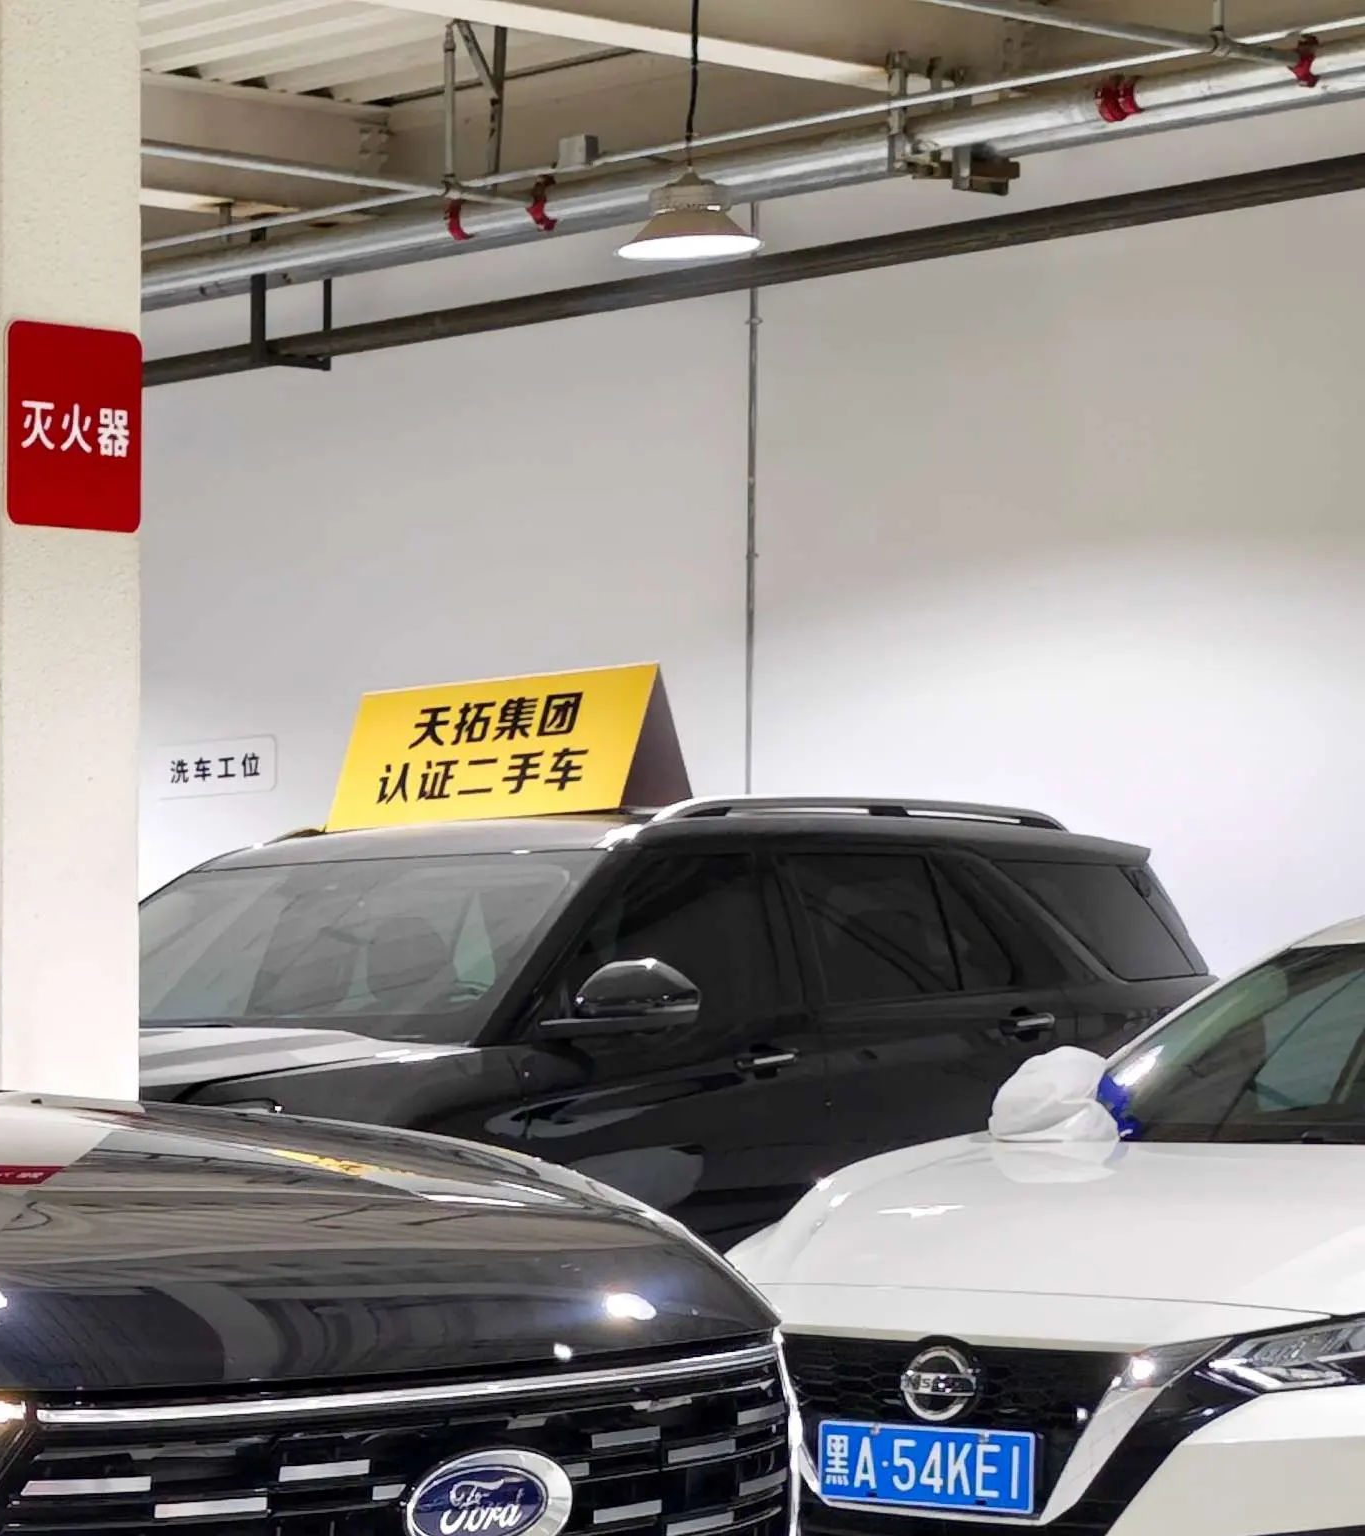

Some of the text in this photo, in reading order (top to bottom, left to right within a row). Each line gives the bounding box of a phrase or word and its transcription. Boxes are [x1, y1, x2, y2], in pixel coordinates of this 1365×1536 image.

[21, 400, 129, 458] 灭火器
[408, 691, 584, 749] 天拓集团
[170, 752, 260, 784] 洗车工位
[376, 747, 589, 805] 认证二手车
[439, 1476, 528, 1536] Ford
